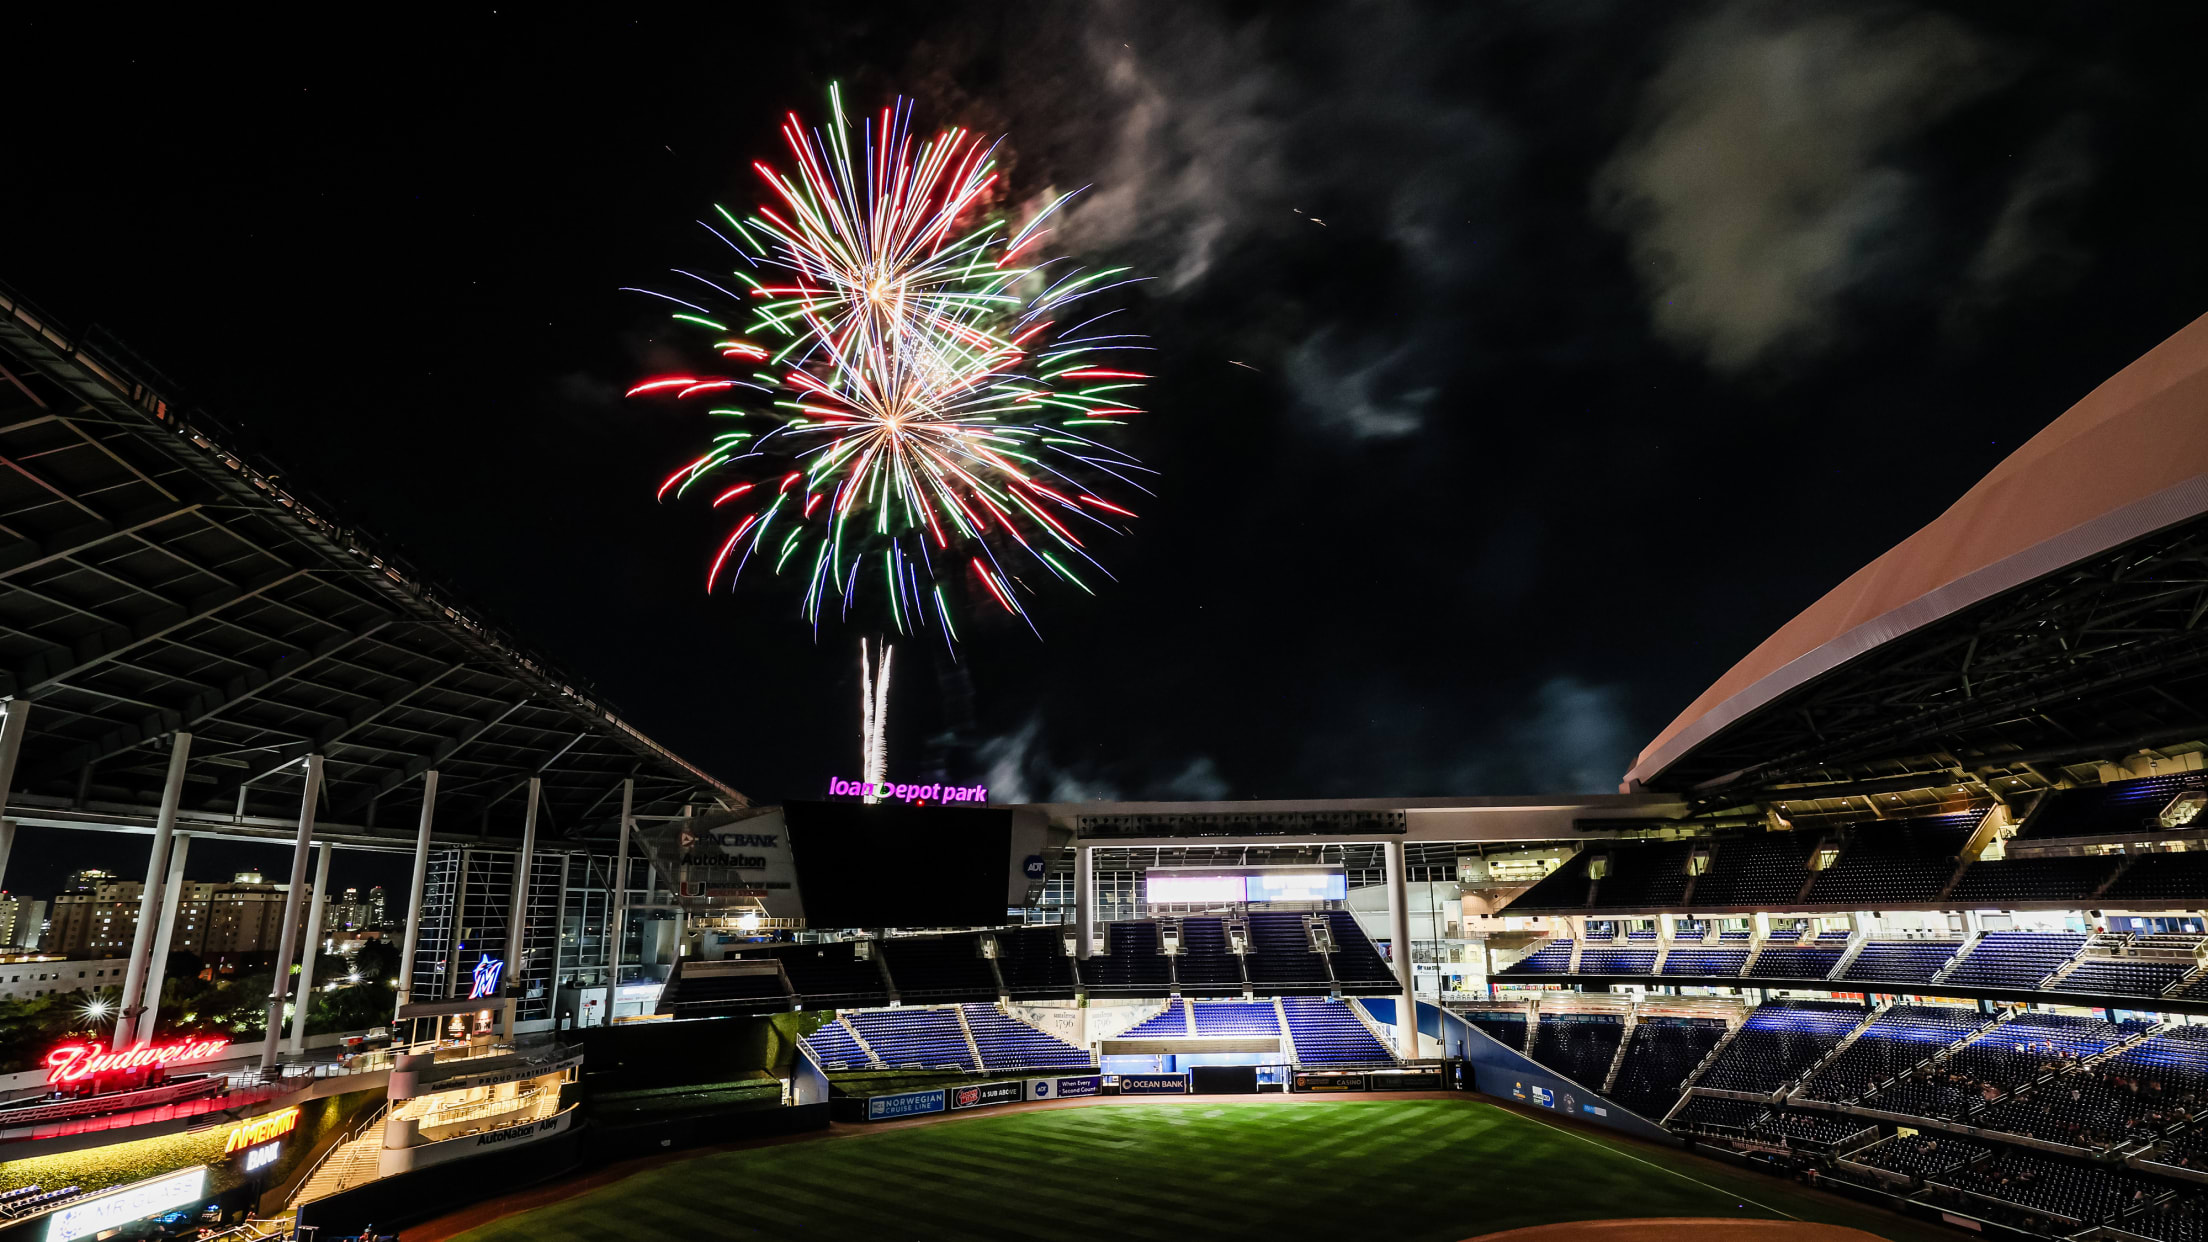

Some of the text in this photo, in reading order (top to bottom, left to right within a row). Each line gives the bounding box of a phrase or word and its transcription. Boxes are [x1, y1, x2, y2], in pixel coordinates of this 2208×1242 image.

[829, 776, 988, 804] loanDepot park
[681, 852, 766, 867] AutoNation
[1028, 862, 1043, 871] ADT
[1055, 1020, 1074, 1029] 1796
[47, 1038, 228, 1083] Budweiser
[478, 1066, 552, 1085] PROUD PARTNERS
[1133, 1080, 1184, 1088] OCEAN BANK
[885, 1093, 943, 1108] NORWEGIAN
[998, 1088, 1018, 1096] ABOVE
[885, 1102, 931, 1115] CRUISE LINE
[225, 1109, 300, 1153] AMERANT
[477, 1118, 559, 1146] AutoNation Alley
[246, 1141, 280, 1171] BANK
[96, 1198, 127, 1217] MR
